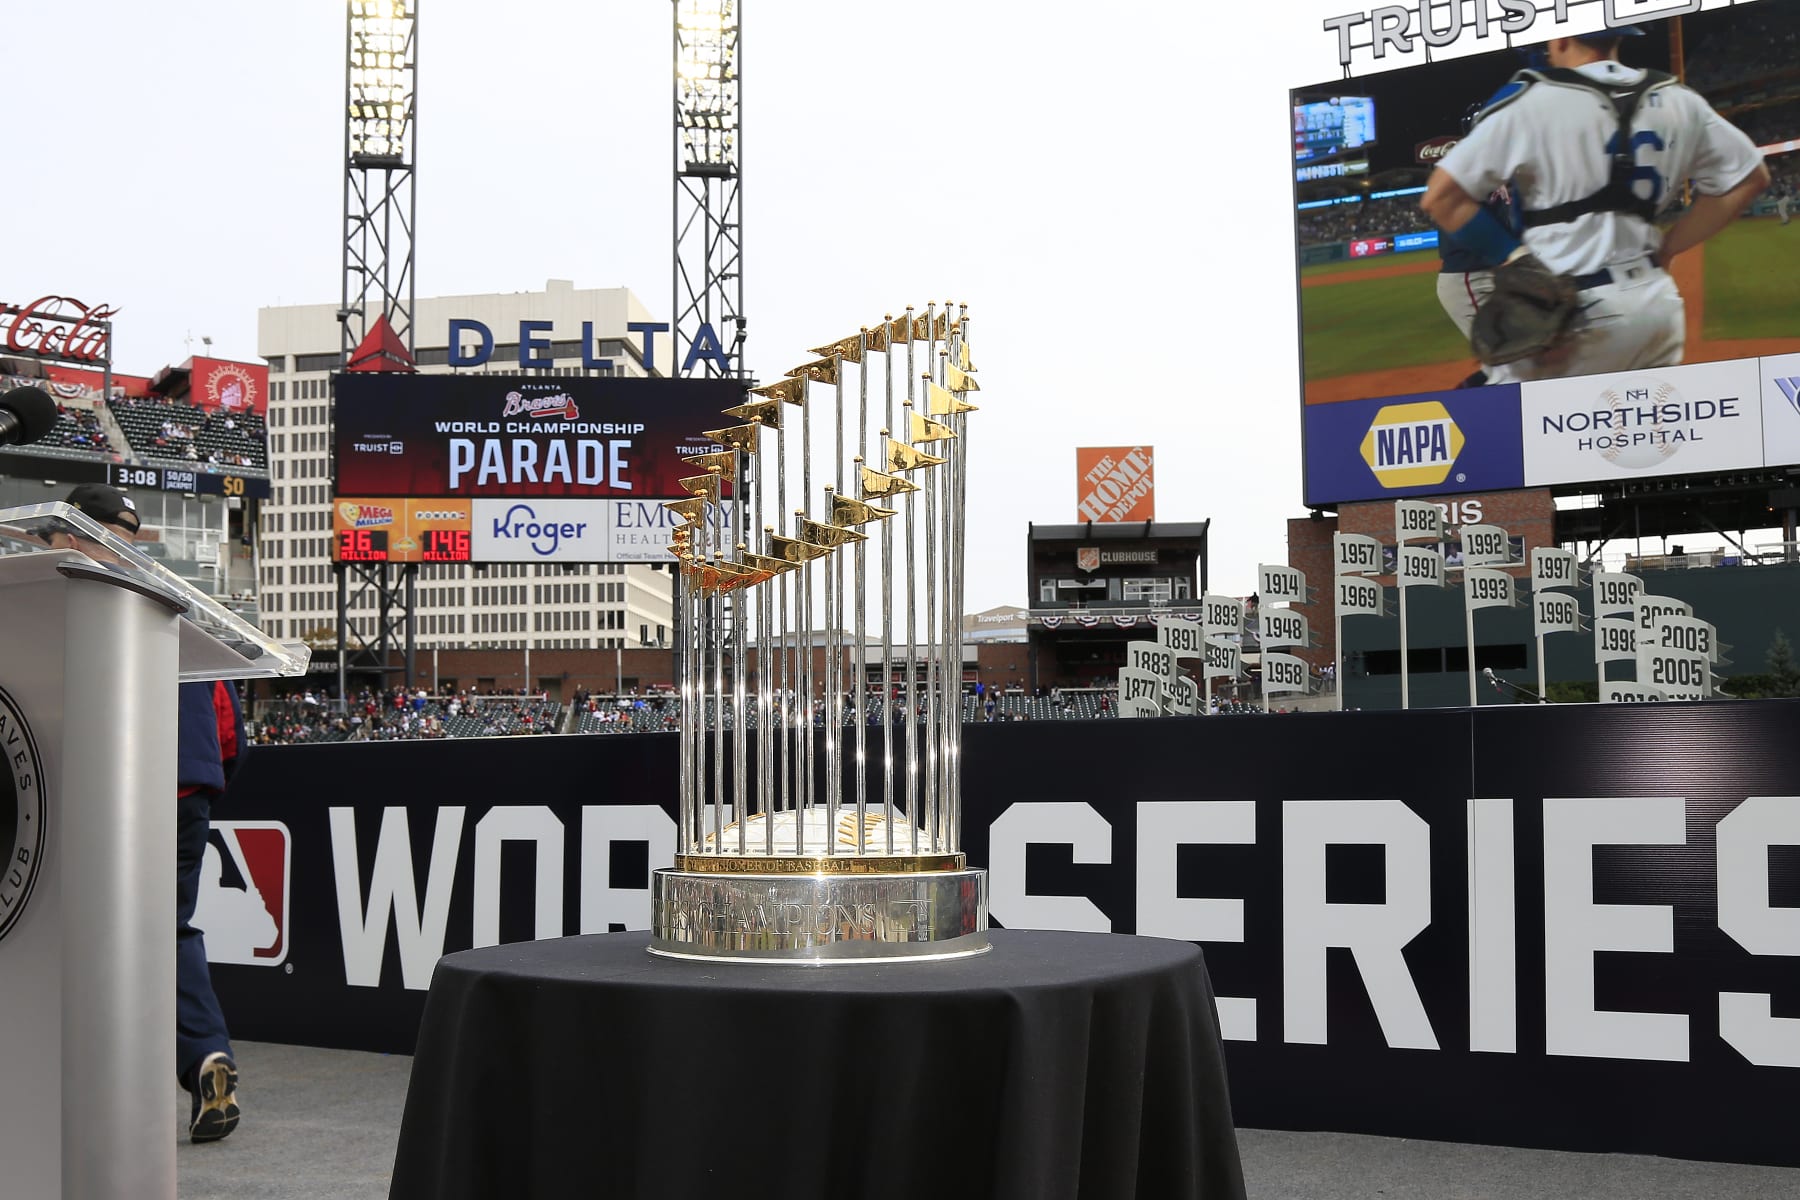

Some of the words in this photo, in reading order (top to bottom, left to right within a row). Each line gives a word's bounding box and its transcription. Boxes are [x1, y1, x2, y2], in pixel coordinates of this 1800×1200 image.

[448, 318, 730, 371] DELTA
[502, 391, 568, 417] Braves
[1626, 388, 1649, 400] NH
[435, 421, 500, 433] WORLD
[506, 422, 645, 434] CHAMPIONSHIP
[1542, 397, 1740, 435] NORTHSIDE
[353, 443, 389, 452] TRUIST
[675, 445, 710, 455] TRUIST
[1377, 423, 1448, 467] NAPA
[1578, 428, 1703, 451] HOSPITAL
[166, 470, 193, 482] 50/50
[449, 438, 633, 490] PARADE
[1084, 454, 1117, 486] THE
[118, 468, 157, 486] 3:08
[166, 480, 193, 490] JACKPOT
[223, 475, 245, 496] $0
[1078, 445, 1154, 523] HOME
[1107, 473, 1154, 522] DEPOT
[358, 504, 393, 519] MEGA
[1401, 509, 1436, 531] 1982
[1433, 500, 1483, 524] RIS
[341, 530, 372, 551] 36
[431, 530, 470, 551] 146
[493, 504, 587, 555] Kroger
[341, 550, 388, 560] MILLION
[423, 551, 469, 560] MILLION
[1340, 543, 1375, 565] 1957
[1467, 533, 1503, 555] 1992
[1101, 551, 1157, 562] CLUBHOUSE
[1404, 555, 1437, 579] 1991
[1537, 556, 1571, 580] 1997
[1264, 573, 1299, 596] 1914
[1340, 584, 1377, 609] 1969
[1470, 577, 1508, 600] 1993
[1599, 581, 1637, 605] 1999
[977, 613, 1014, 624] Travelport
[1207, 603, 1238, 627] 1893
[1539, 601, 1573, 625] 1996
[1164, 627, 1199, 651] 1891
[1265, 616, 1303, 640] 1948
[1661, 624, 1710, 654] 2003
[1133, 650, 1171, 676] 1883
[1267, 661, 1303, 685] 1958
[1652, 657, 1703, 687] 2005
[1124, 676, 1156, 701] 1877
[0, 846, 30, 909] LUB
[786, 858, 852, 873] BASEBAL
[698, 900, 876, 936] CHAMPIONS
[328, 804, 679, 991] WOR
[988, 796, 1800, 1069] SERIES
